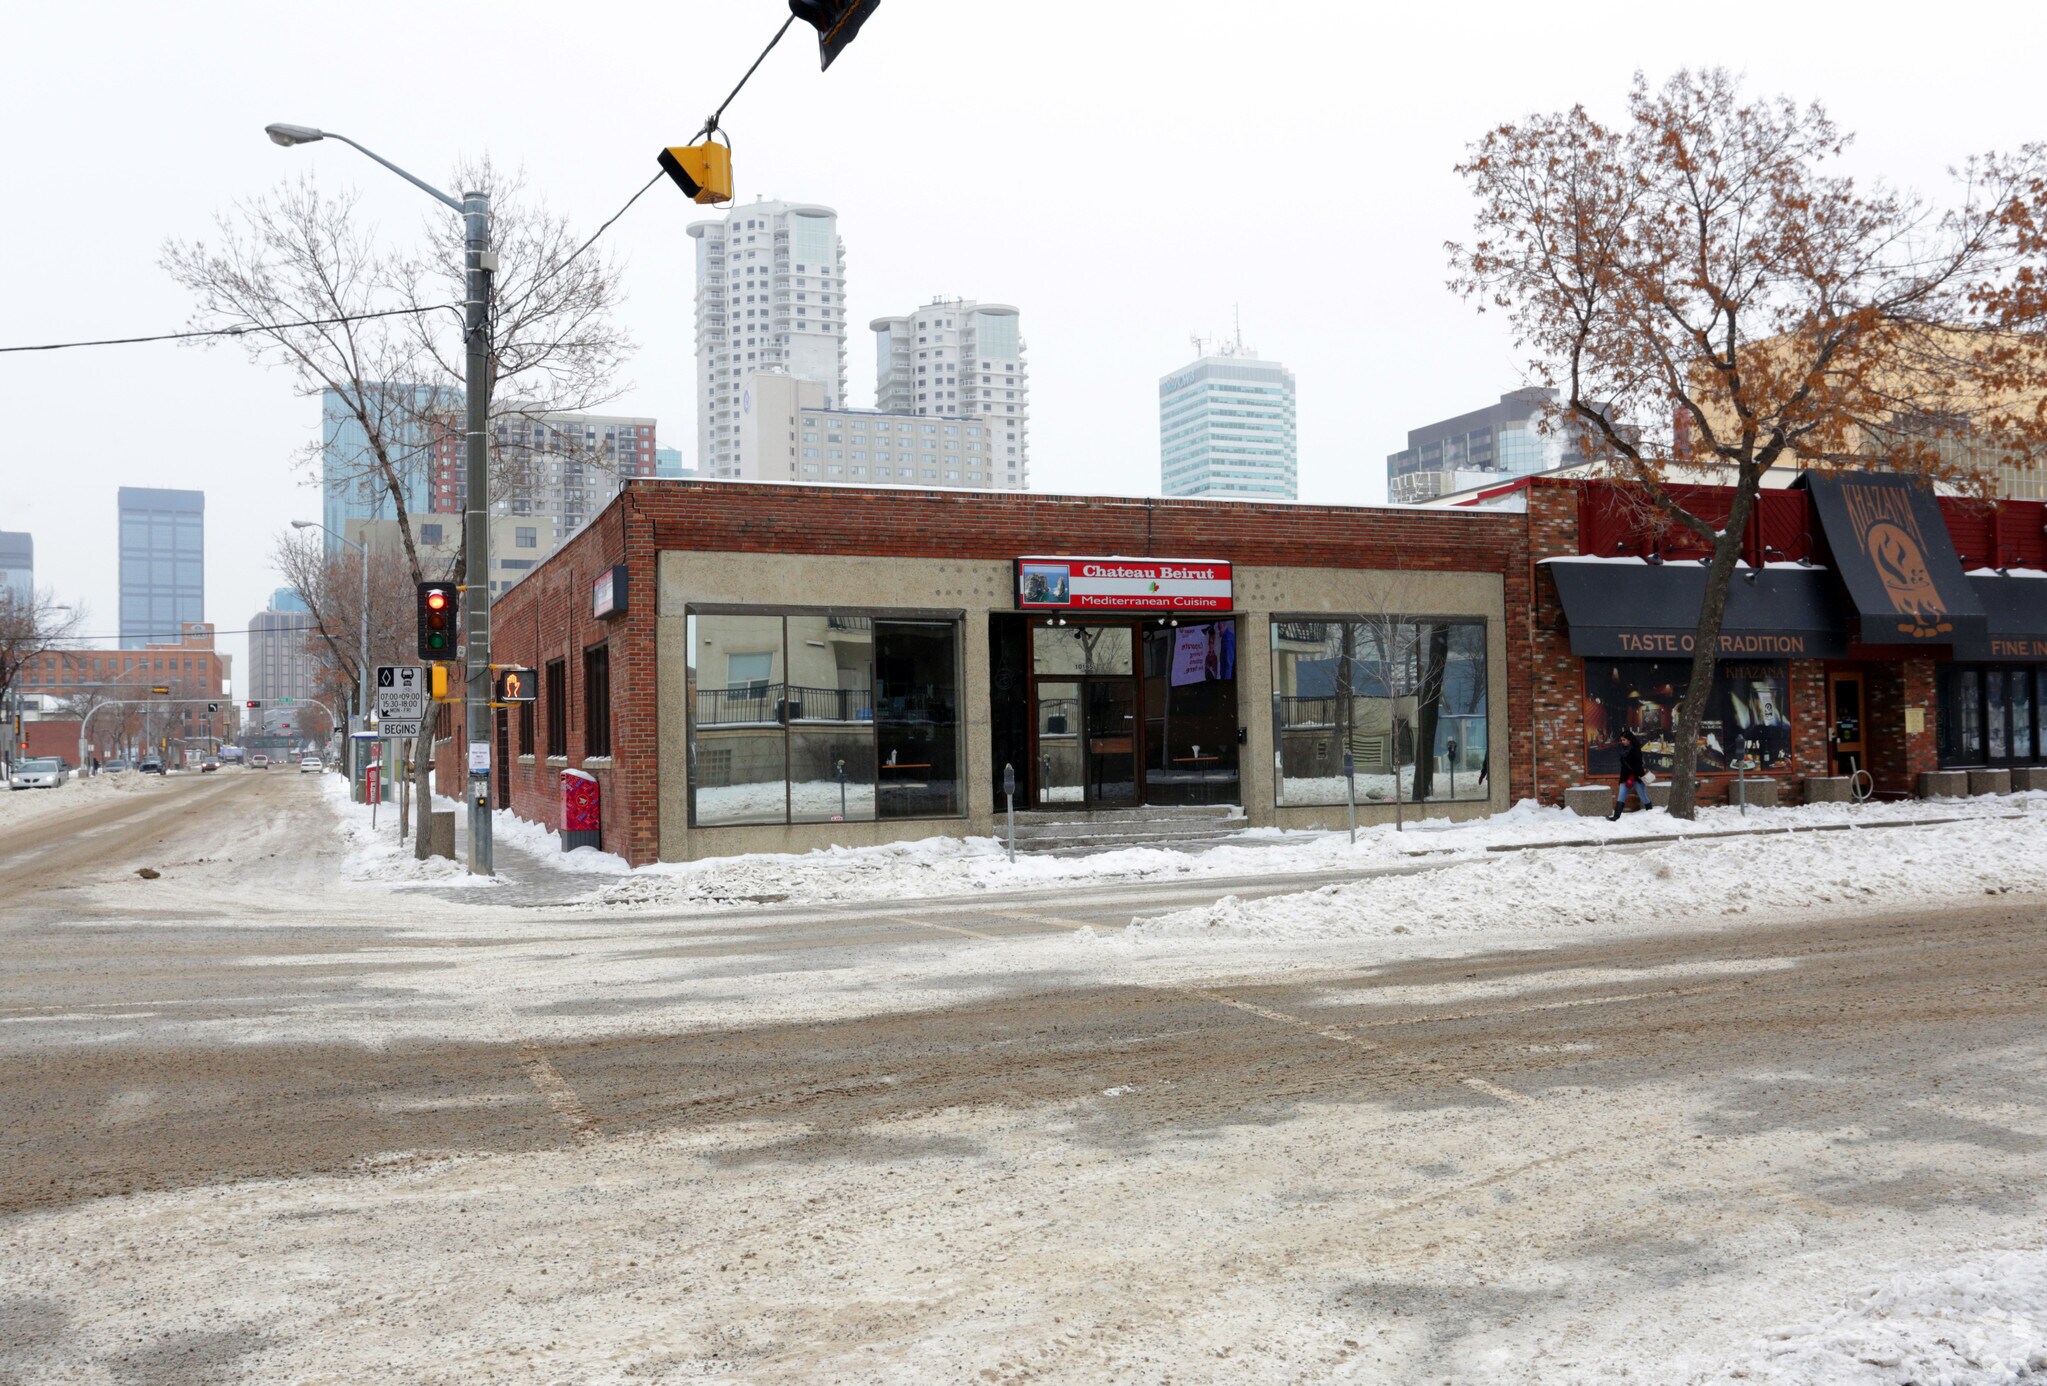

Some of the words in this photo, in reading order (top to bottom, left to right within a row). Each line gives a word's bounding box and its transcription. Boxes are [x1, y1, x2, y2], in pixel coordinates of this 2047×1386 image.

[1842, 485, 1929, 556] KHAZANA
[1083, 565, 1156, 578] Chateau
[1159, 567, 1214, 579] Beirut
[1081, 596, 1170, 606] Mediterranean
[1173, 597, 1217, 606] Cuisine
[1618, 633, 1678, 651] TASTE
[1681, 634, 1697, 651] O
[1717, 635, 1805, 652] RADITION
[1991, 640, 2030, 656] FINE
[1726, 666, 1785, 679] KHAZANA
[384, 724, 416, 734] BEGINS
